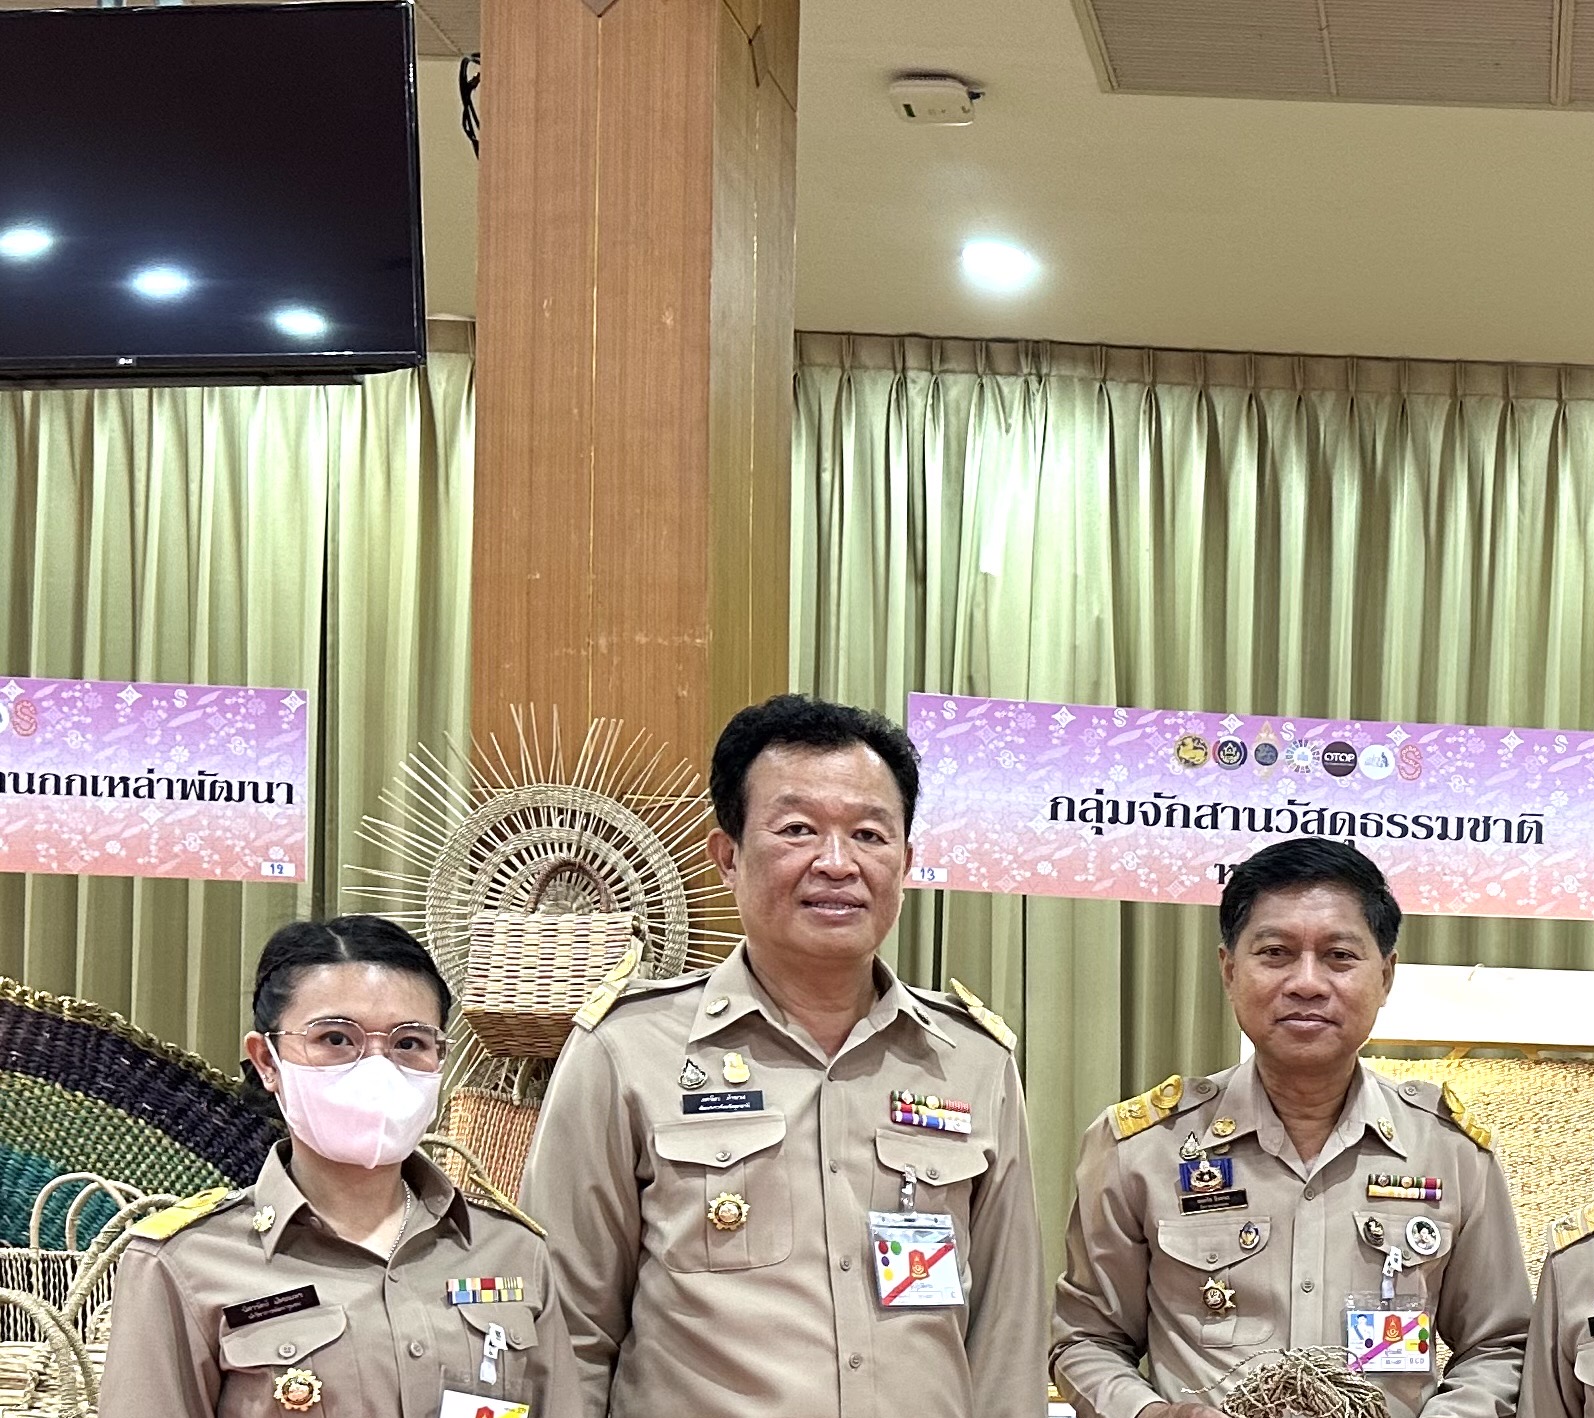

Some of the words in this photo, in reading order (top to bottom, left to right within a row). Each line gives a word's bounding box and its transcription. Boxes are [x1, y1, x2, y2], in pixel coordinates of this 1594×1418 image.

[1323, 752, 1356, 763] OTOP
[1049, 789, 1544, 847] กลุ่มจักสานวัสดุธรรมชาติ
[919, 867, 936, 882] 13
